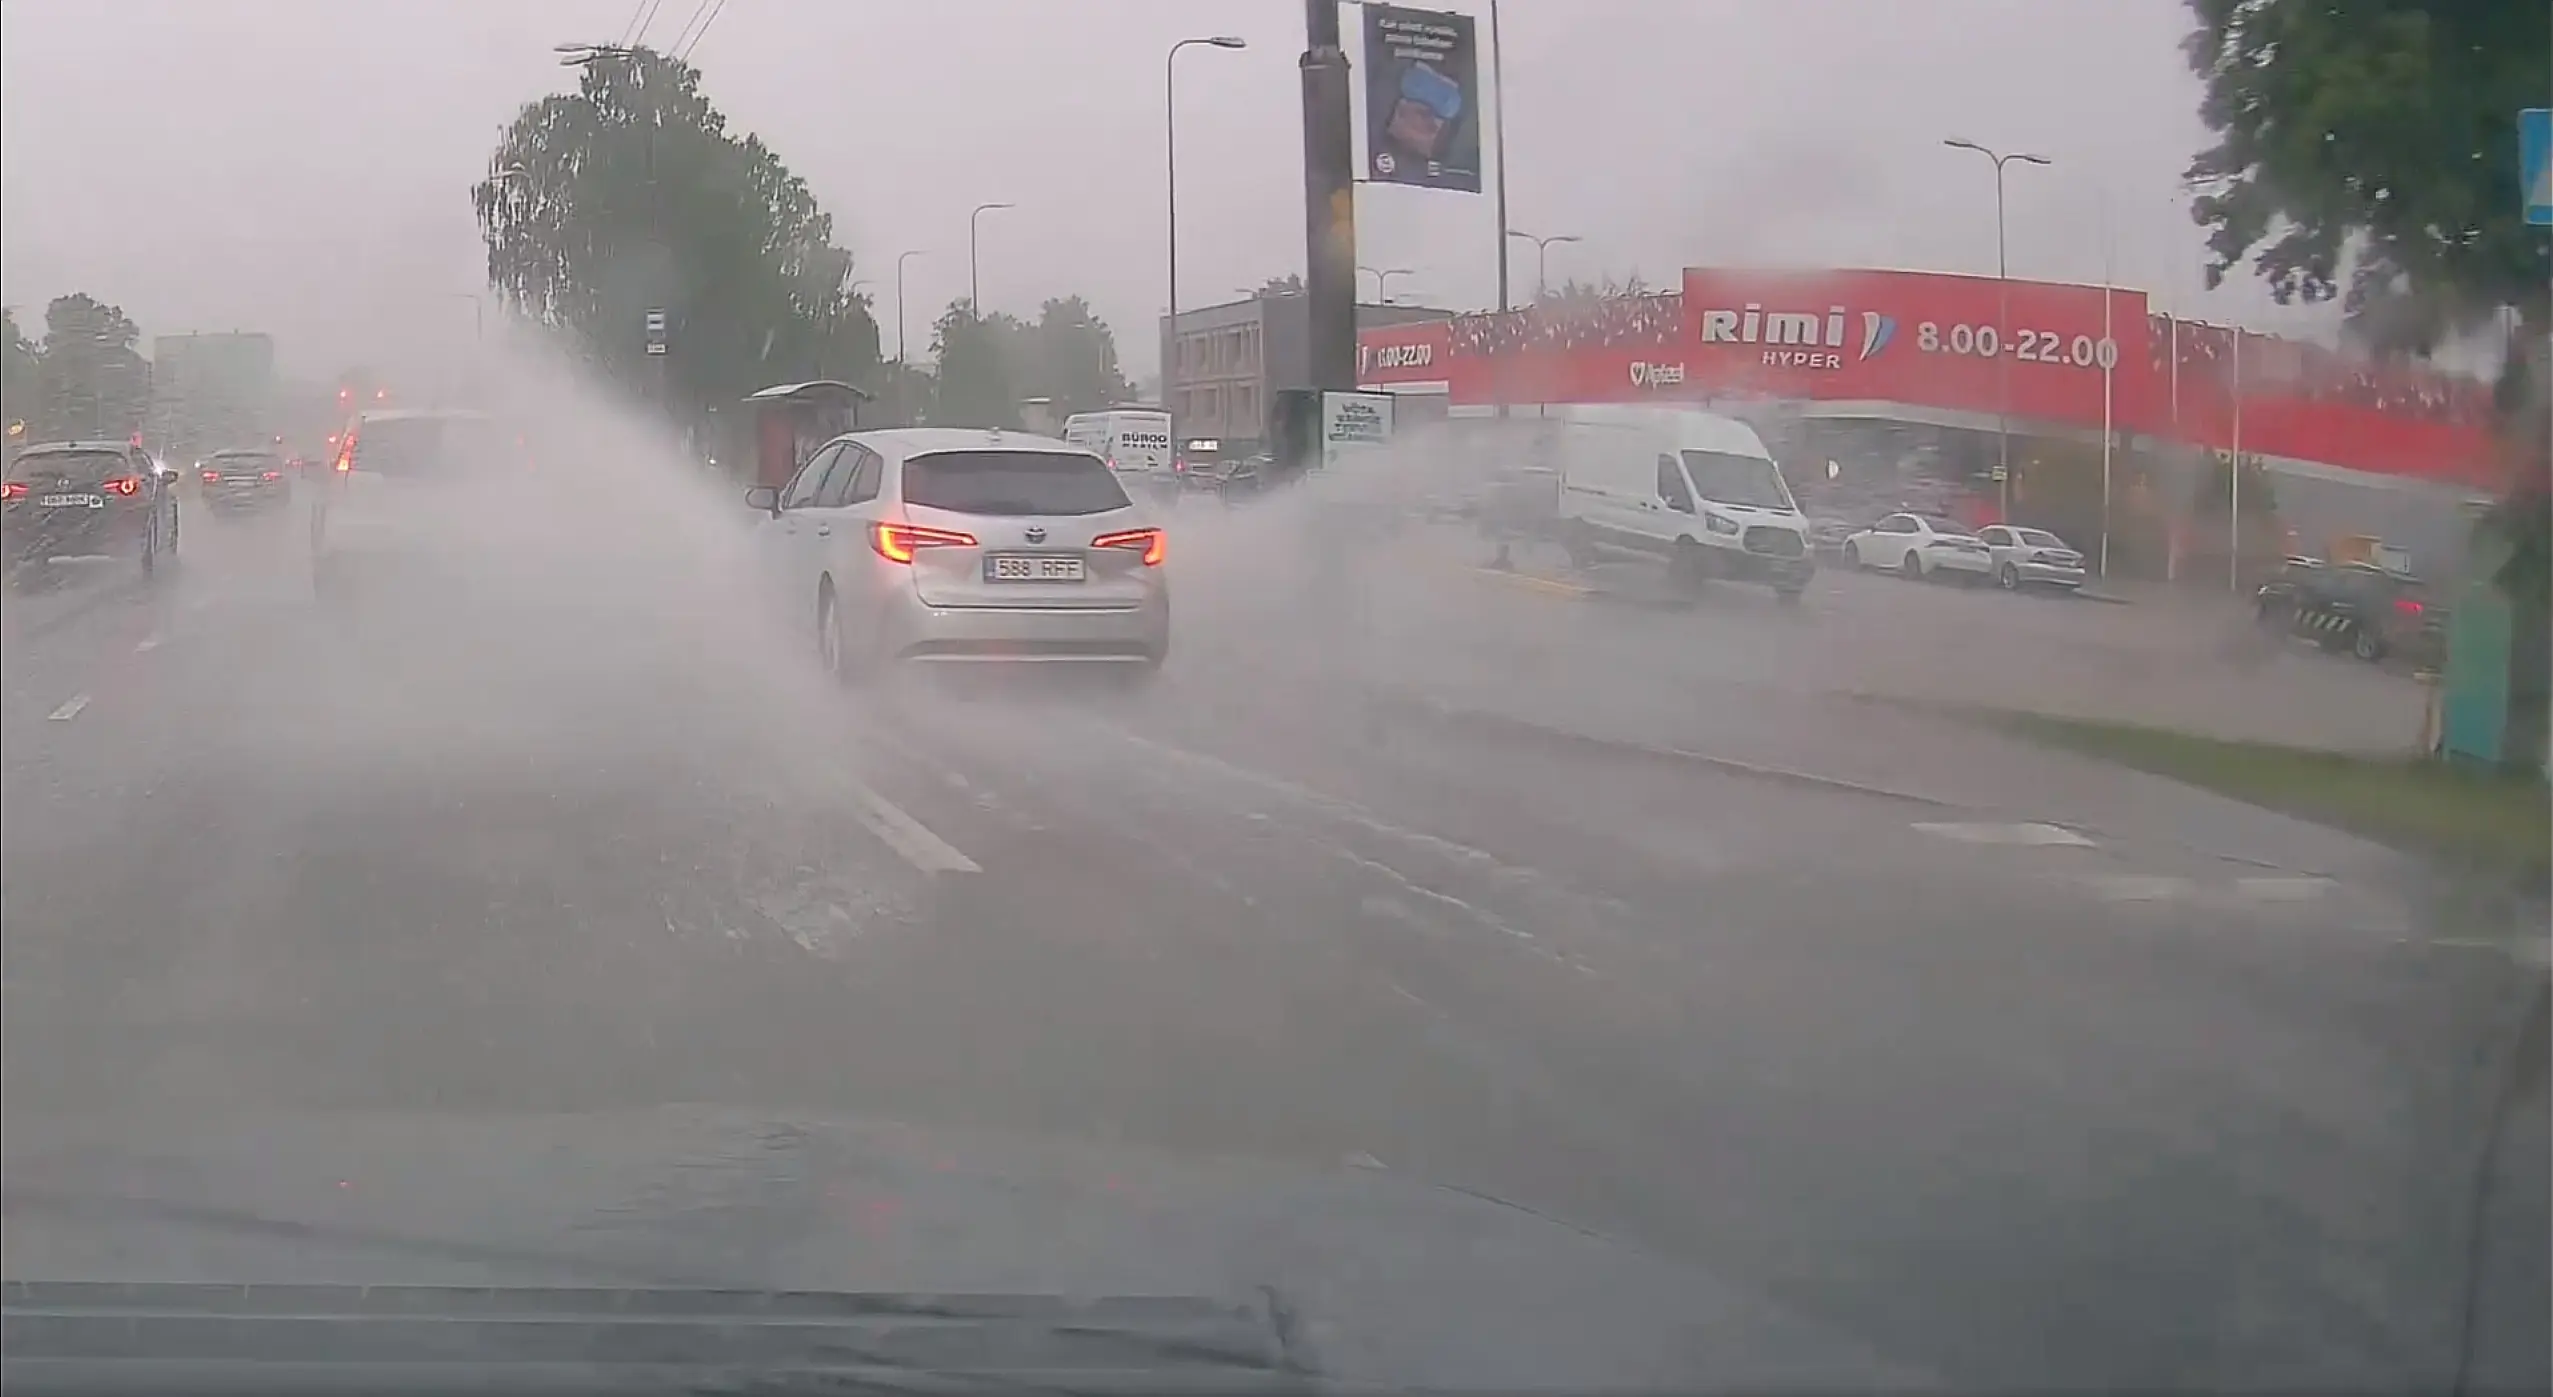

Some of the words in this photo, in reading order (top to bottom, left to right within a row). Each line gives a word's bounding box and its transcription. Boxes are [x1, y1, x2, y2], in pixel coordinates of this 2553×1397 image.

[1701, 303, 1846, 347] Rimi
[1762, 351, 1841, 369] HYPER
[1917, 321, 2118, 369] 8.00-22.00
[998, 560, 1031, 577] 588
[1041, 560, 1080, 577] RFF
